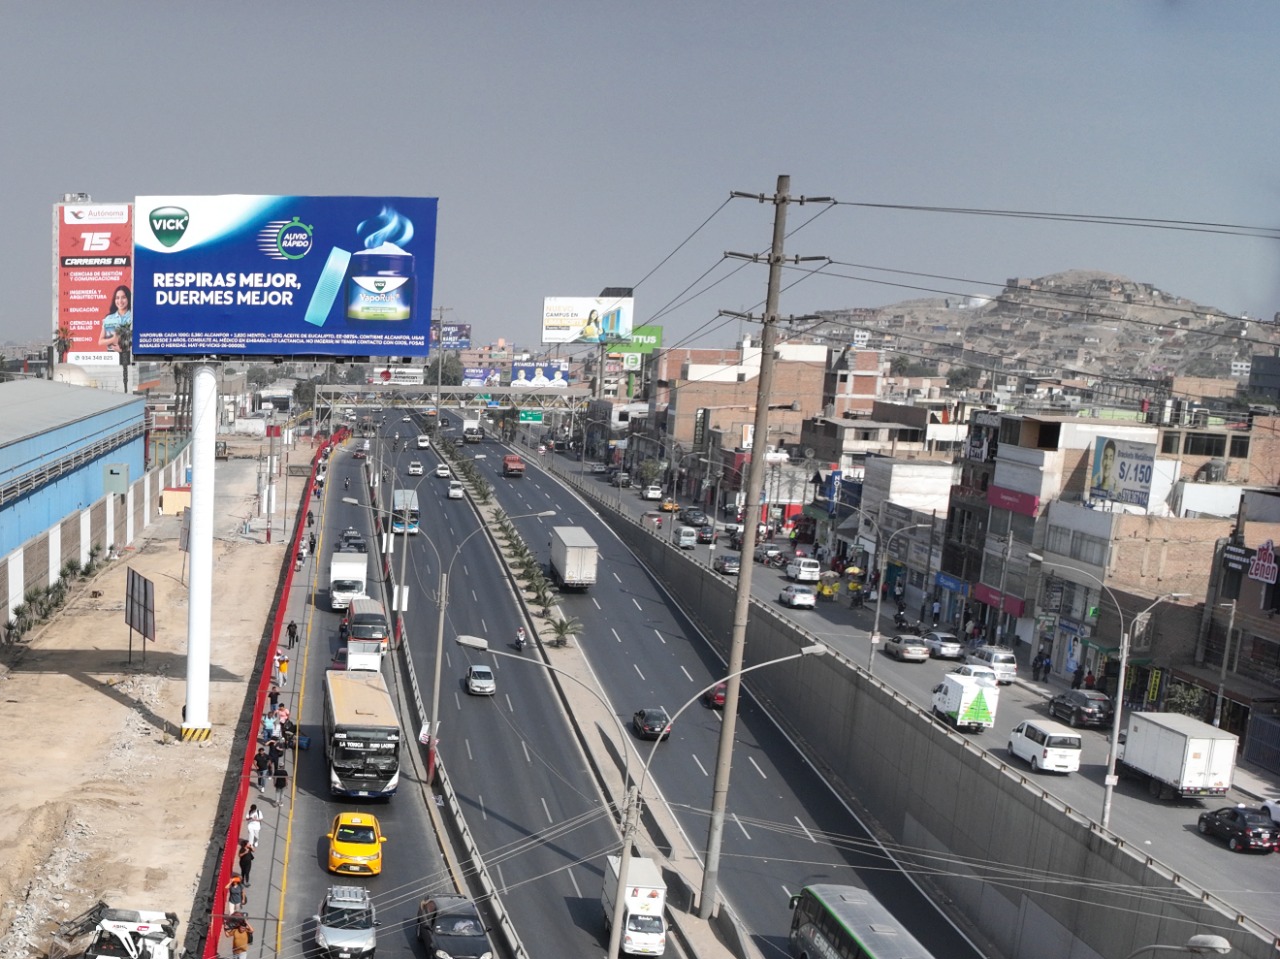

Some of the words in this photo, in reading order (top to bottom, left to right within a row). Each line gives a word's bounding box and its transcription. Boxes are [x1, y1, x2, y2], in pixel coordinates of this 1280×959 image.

[153, 219, 185, 230] VICK
[80, 232, 112, 252] 15
[282, 239, 308, 247] RÁPIDO
[153, 272, 236, 288] RESPIRAS
[239, 273, 301, 290] MEJOR,
[156, 290, 234, 305] DUERMES
[237, 290, 293, 305] MEJOR
[1119, 461, 1152, 483] S/.150
